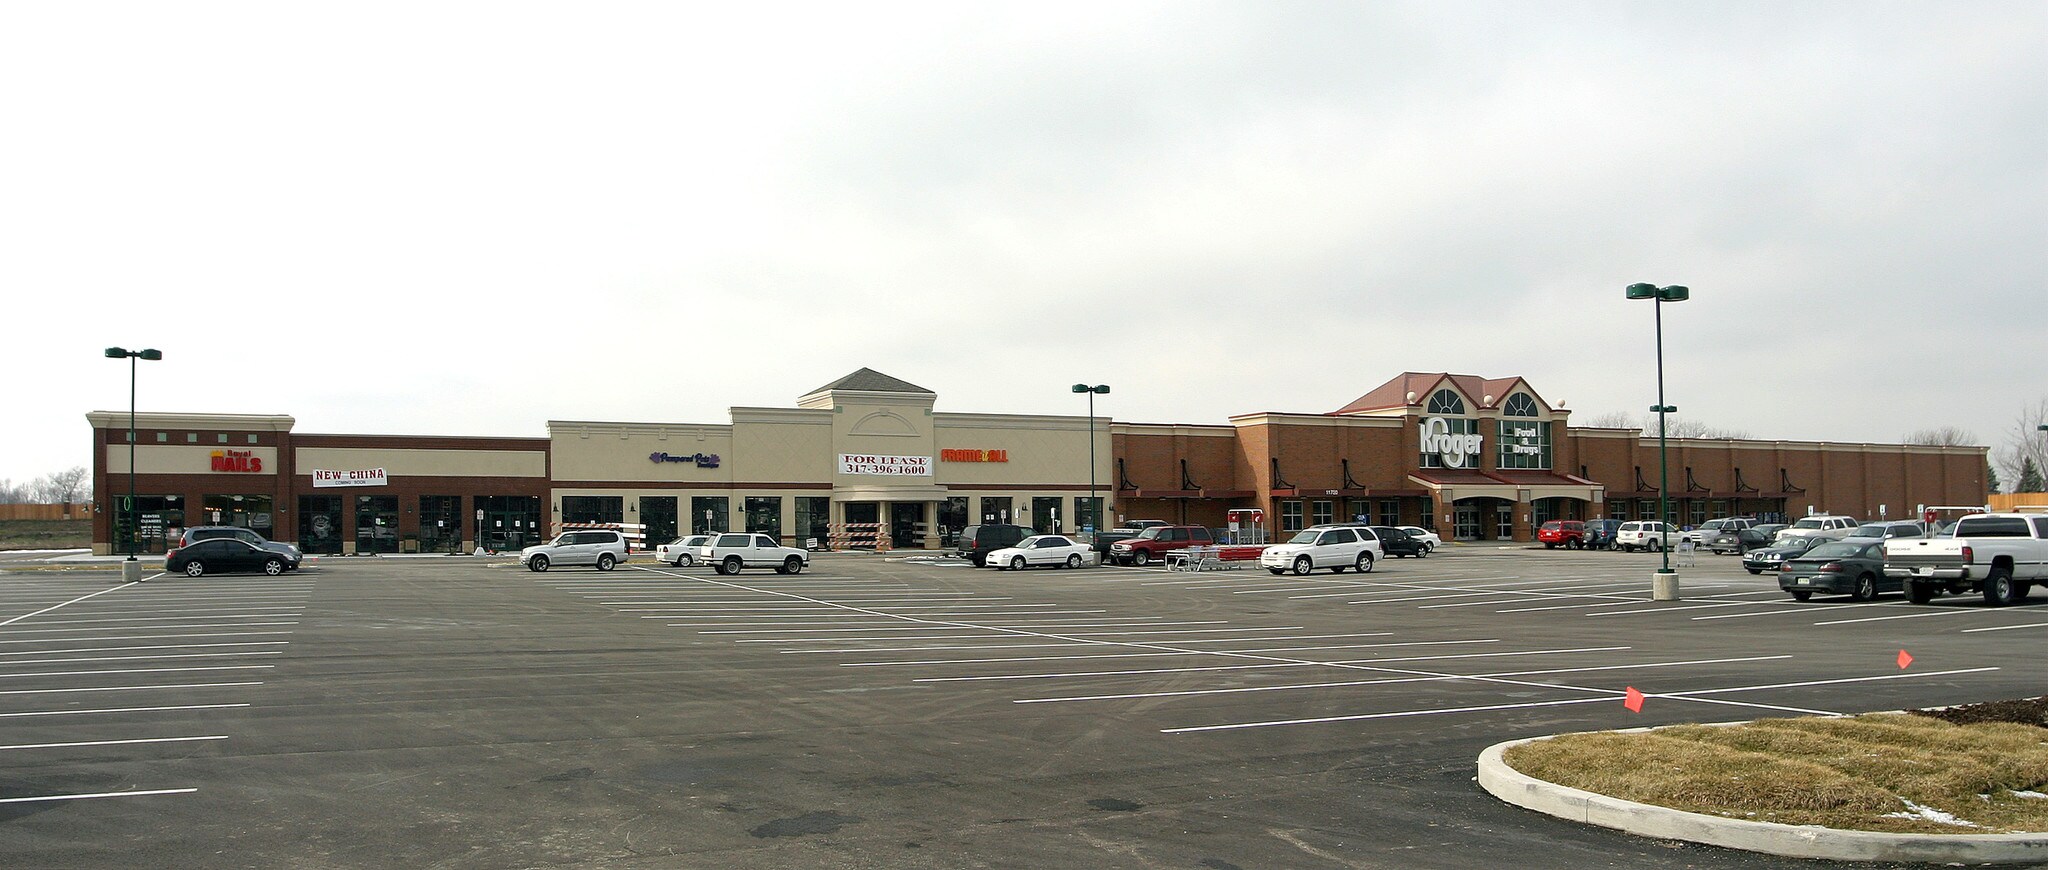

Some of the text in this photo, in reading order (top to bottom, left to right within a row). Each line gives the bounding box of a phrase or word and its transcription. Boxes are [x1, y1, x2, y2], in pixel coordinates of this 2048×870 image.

[1514, 427, 1537, 438] Food
[1419, 416, 1484, 469] Kroger
[1521, 437, 1529, 445] &
[1512, 444, 1539, 456] Drugs
[211, 456, 262, 473] NAILS
[844, 455, 928, 466] FOR LEASE
[316, 469, 384, 480] NEW CHINA
